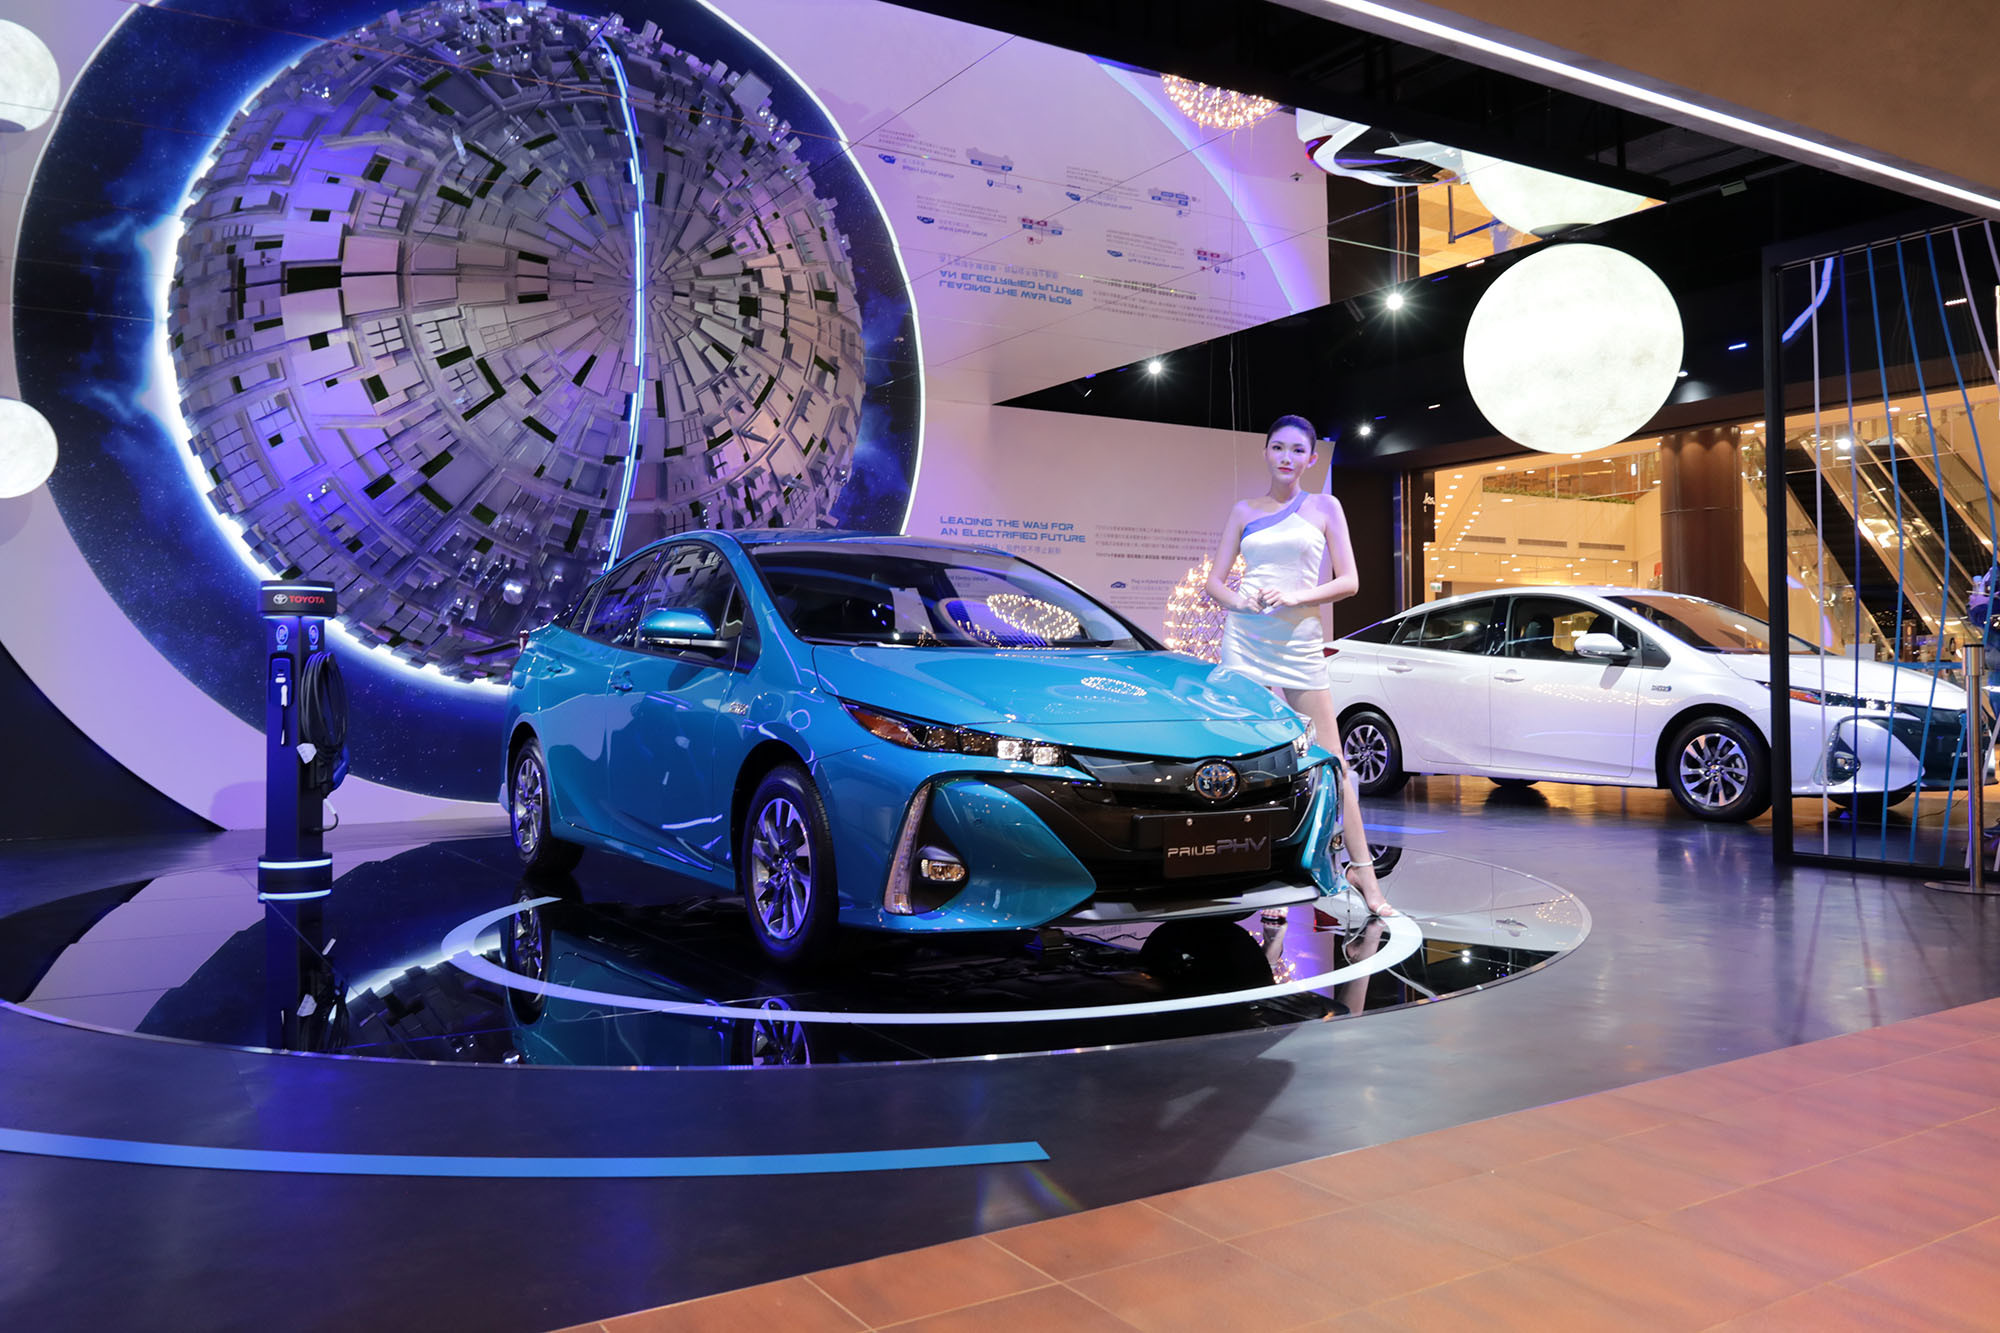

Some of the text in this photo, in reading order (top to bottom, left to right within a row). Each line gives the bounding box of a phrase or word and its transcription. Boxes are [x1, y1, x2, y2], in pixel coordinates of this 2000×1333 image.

[940, 516, 1074, 531] LEADING THE WAY FOR
[940, 527, 1086, 543] AN ELECTRIFIED FUTURE
[288, 595, 325, 604] TOYOTA
